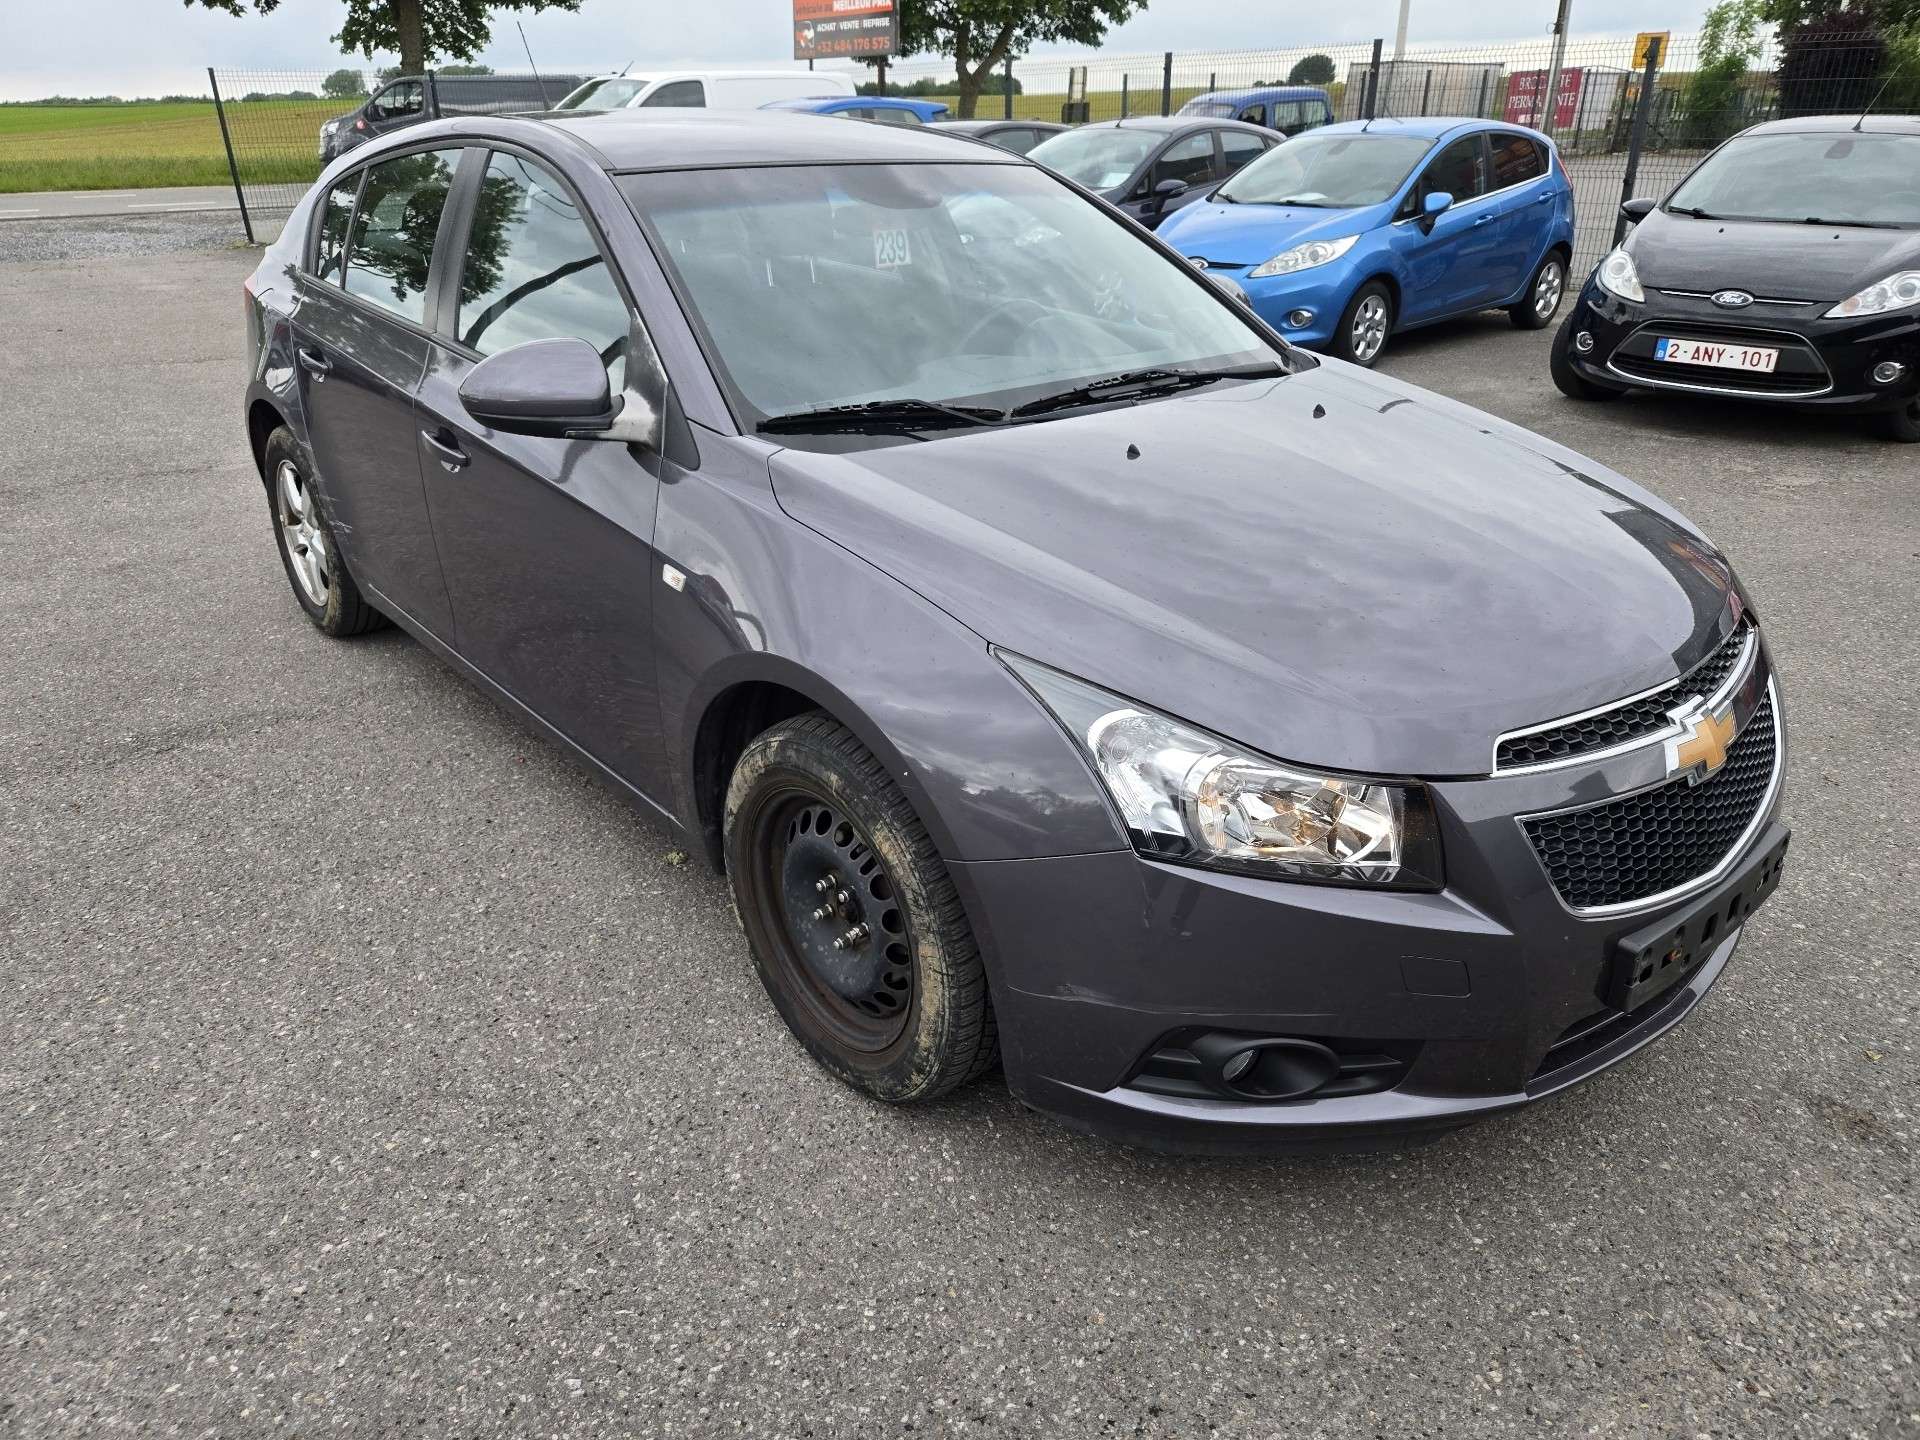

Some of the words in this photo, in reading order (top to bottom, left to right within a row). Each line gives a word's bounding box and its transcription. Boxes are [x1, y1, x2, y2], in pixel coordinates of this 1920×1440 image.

[833, 0, 870, 11] MEILLEUR
[871, 0, 892, 8] PRIX
[817, 22, 837, 32] ACHAT
[840, 20, 860, 31] VENTE
[863, 17, 890, 28] REPRISE
[853, 37, 870, 50] 176
[872, 36, 890, 49] 575
[1519, 74, 1573, 91] BROCTE
[1508, 92, 1576, 109] PERMANTE
[876, 230, 907, 264] 239
[1719, 290, 1745, 304] Ford
